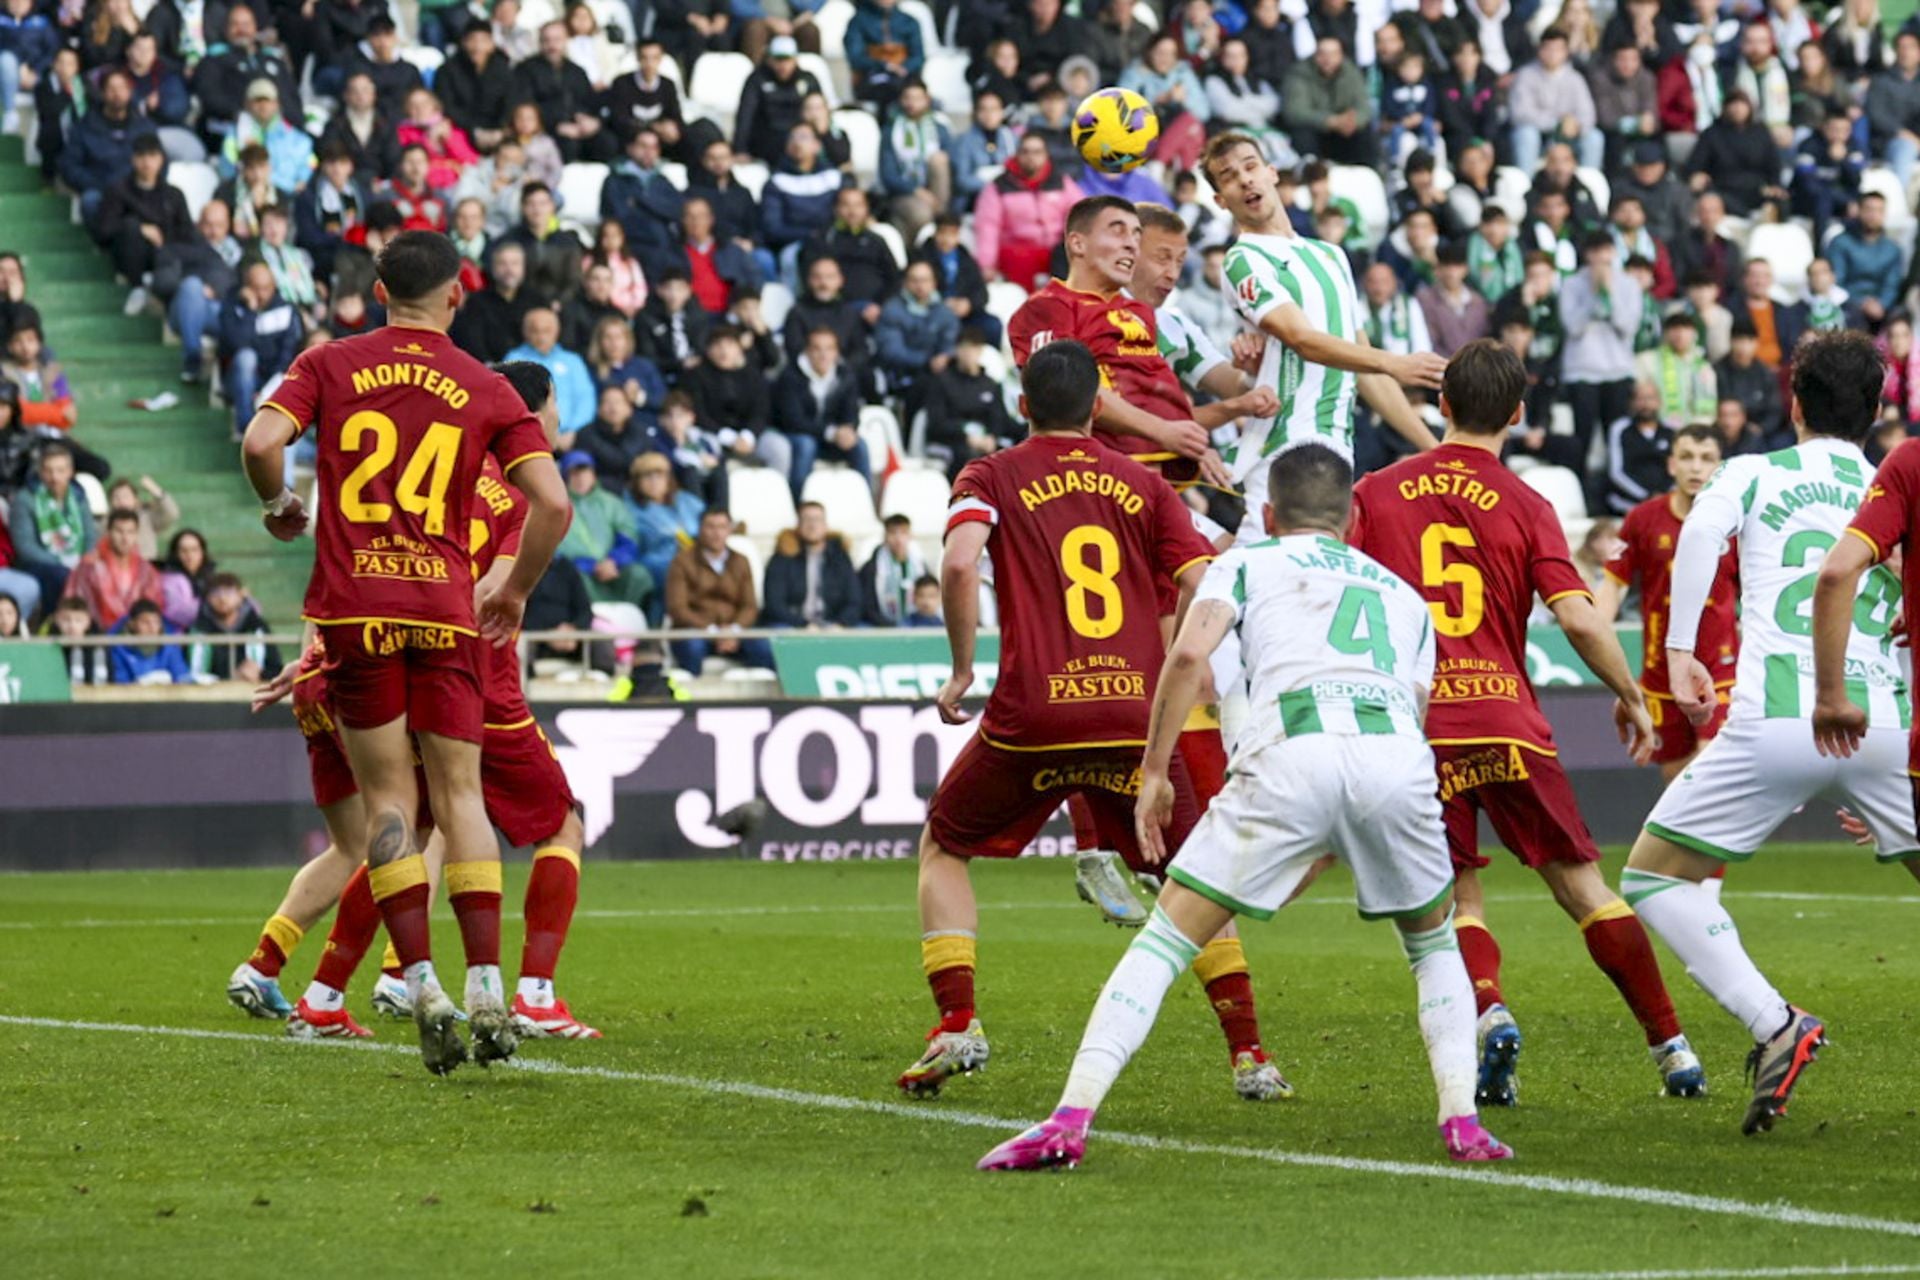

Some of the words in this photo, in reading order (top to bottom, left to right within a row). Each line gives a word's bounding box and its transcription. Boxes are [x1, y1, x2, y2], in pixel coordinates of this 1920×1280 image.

[352, 364, 470, 410] MONTERO
[340, 410, 464, 535] 24
[1019, 470, 1144, 515] ALDASORO
[1399, 474, 1500, 512] CASTRO
[372, 536, 390, 550] EL
[354, 554, 448, 578] PASTOR
[1061, 525, 1123, 639] 8
[1420, 523, 1483, 637] 5
[1327, 585, 1397, 675] 4
[1066, 659, 1085, 673] EL
[1088, 655, 1126, 669] BUEN
[1439, 658, 1458, 673] EL
[1459, 658, 1498, 671] BUEN
[1049, 676, 1145, 698] PASTOR
[1312, 681, 1388, 703] PIEDRA
